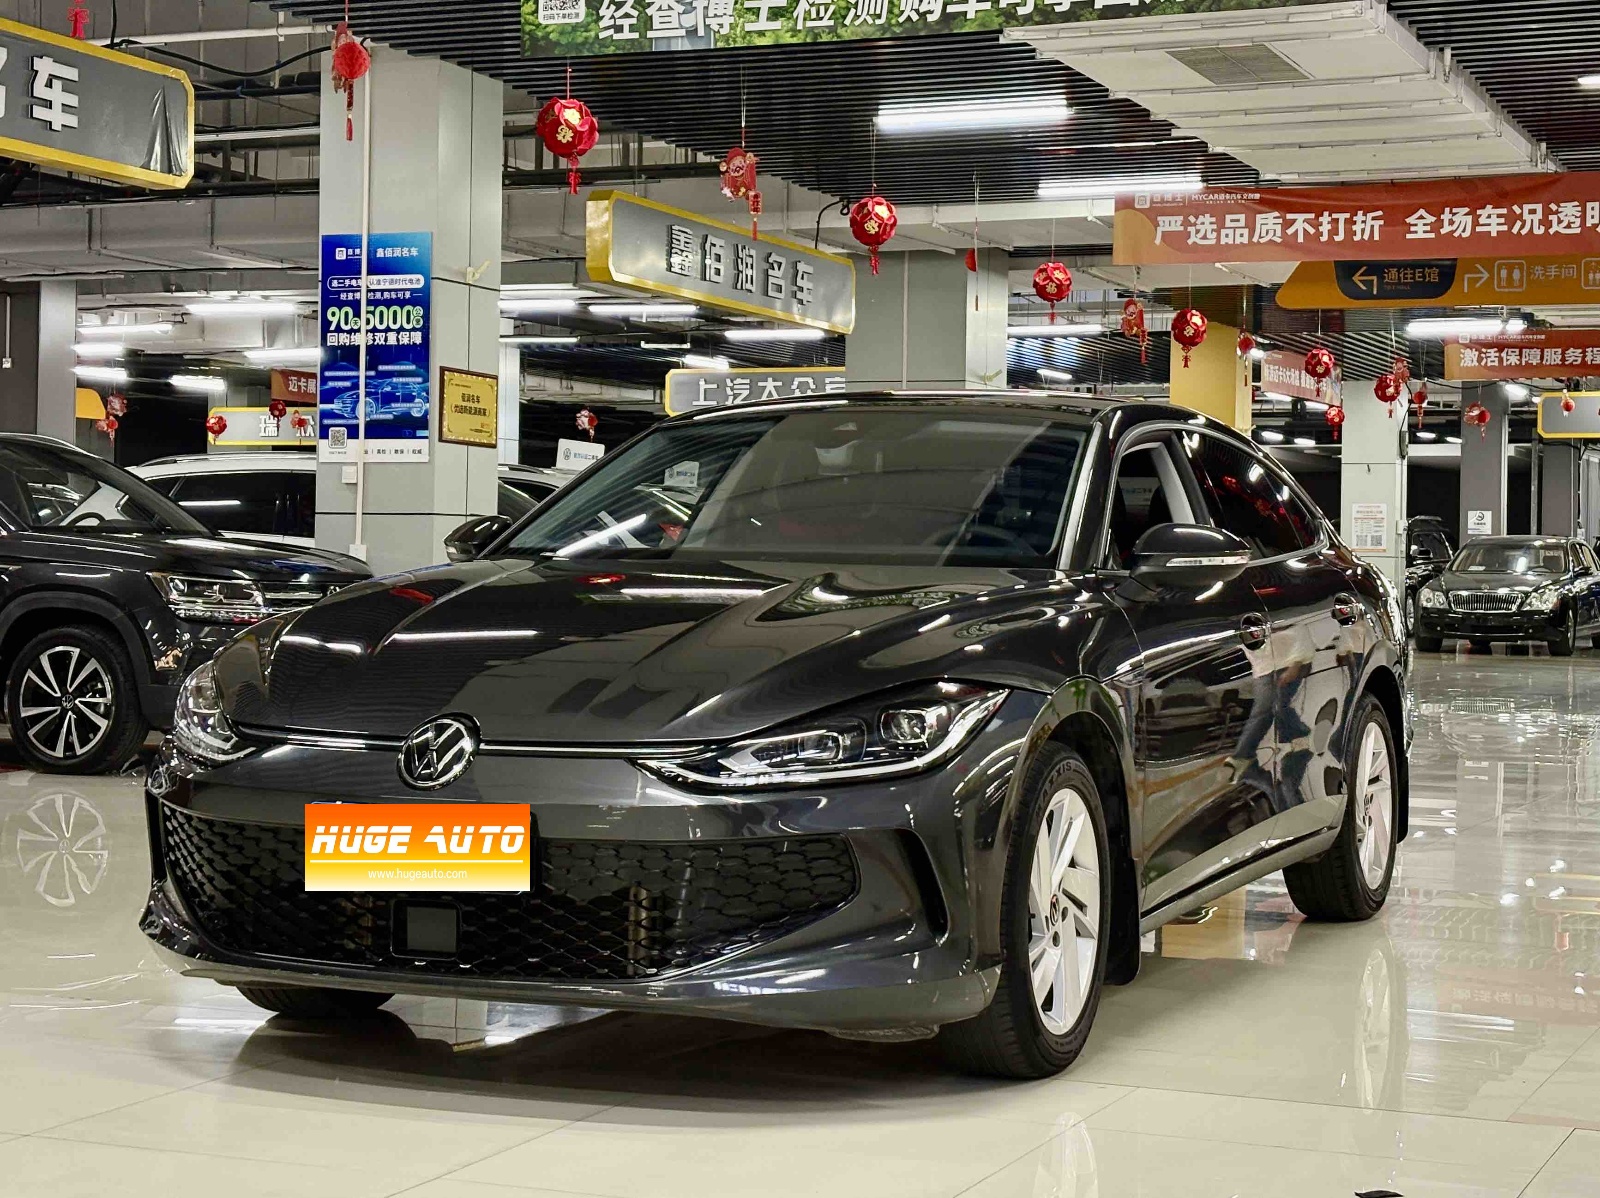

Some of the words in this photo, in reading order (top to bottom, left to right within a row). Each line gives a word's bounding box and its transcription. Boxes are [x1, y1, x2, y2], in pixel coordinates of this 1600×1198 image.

[1154, 210, 1385, 246] 严选品质不打折
[376, 247, 419, 258] 鑫佰润名车
[666, 224, 814, 306] 鑫佰润名车
[1383, 267, 1440, 283] 通往E馆
[1530, 264, 1577, 280] 洗手间
[369, 278, 421, 286] 认准宁德时代电池
[340, 291, 411, 301] 经查博检测,购车可享
[288, 376, 316, 394] 迈卡展
